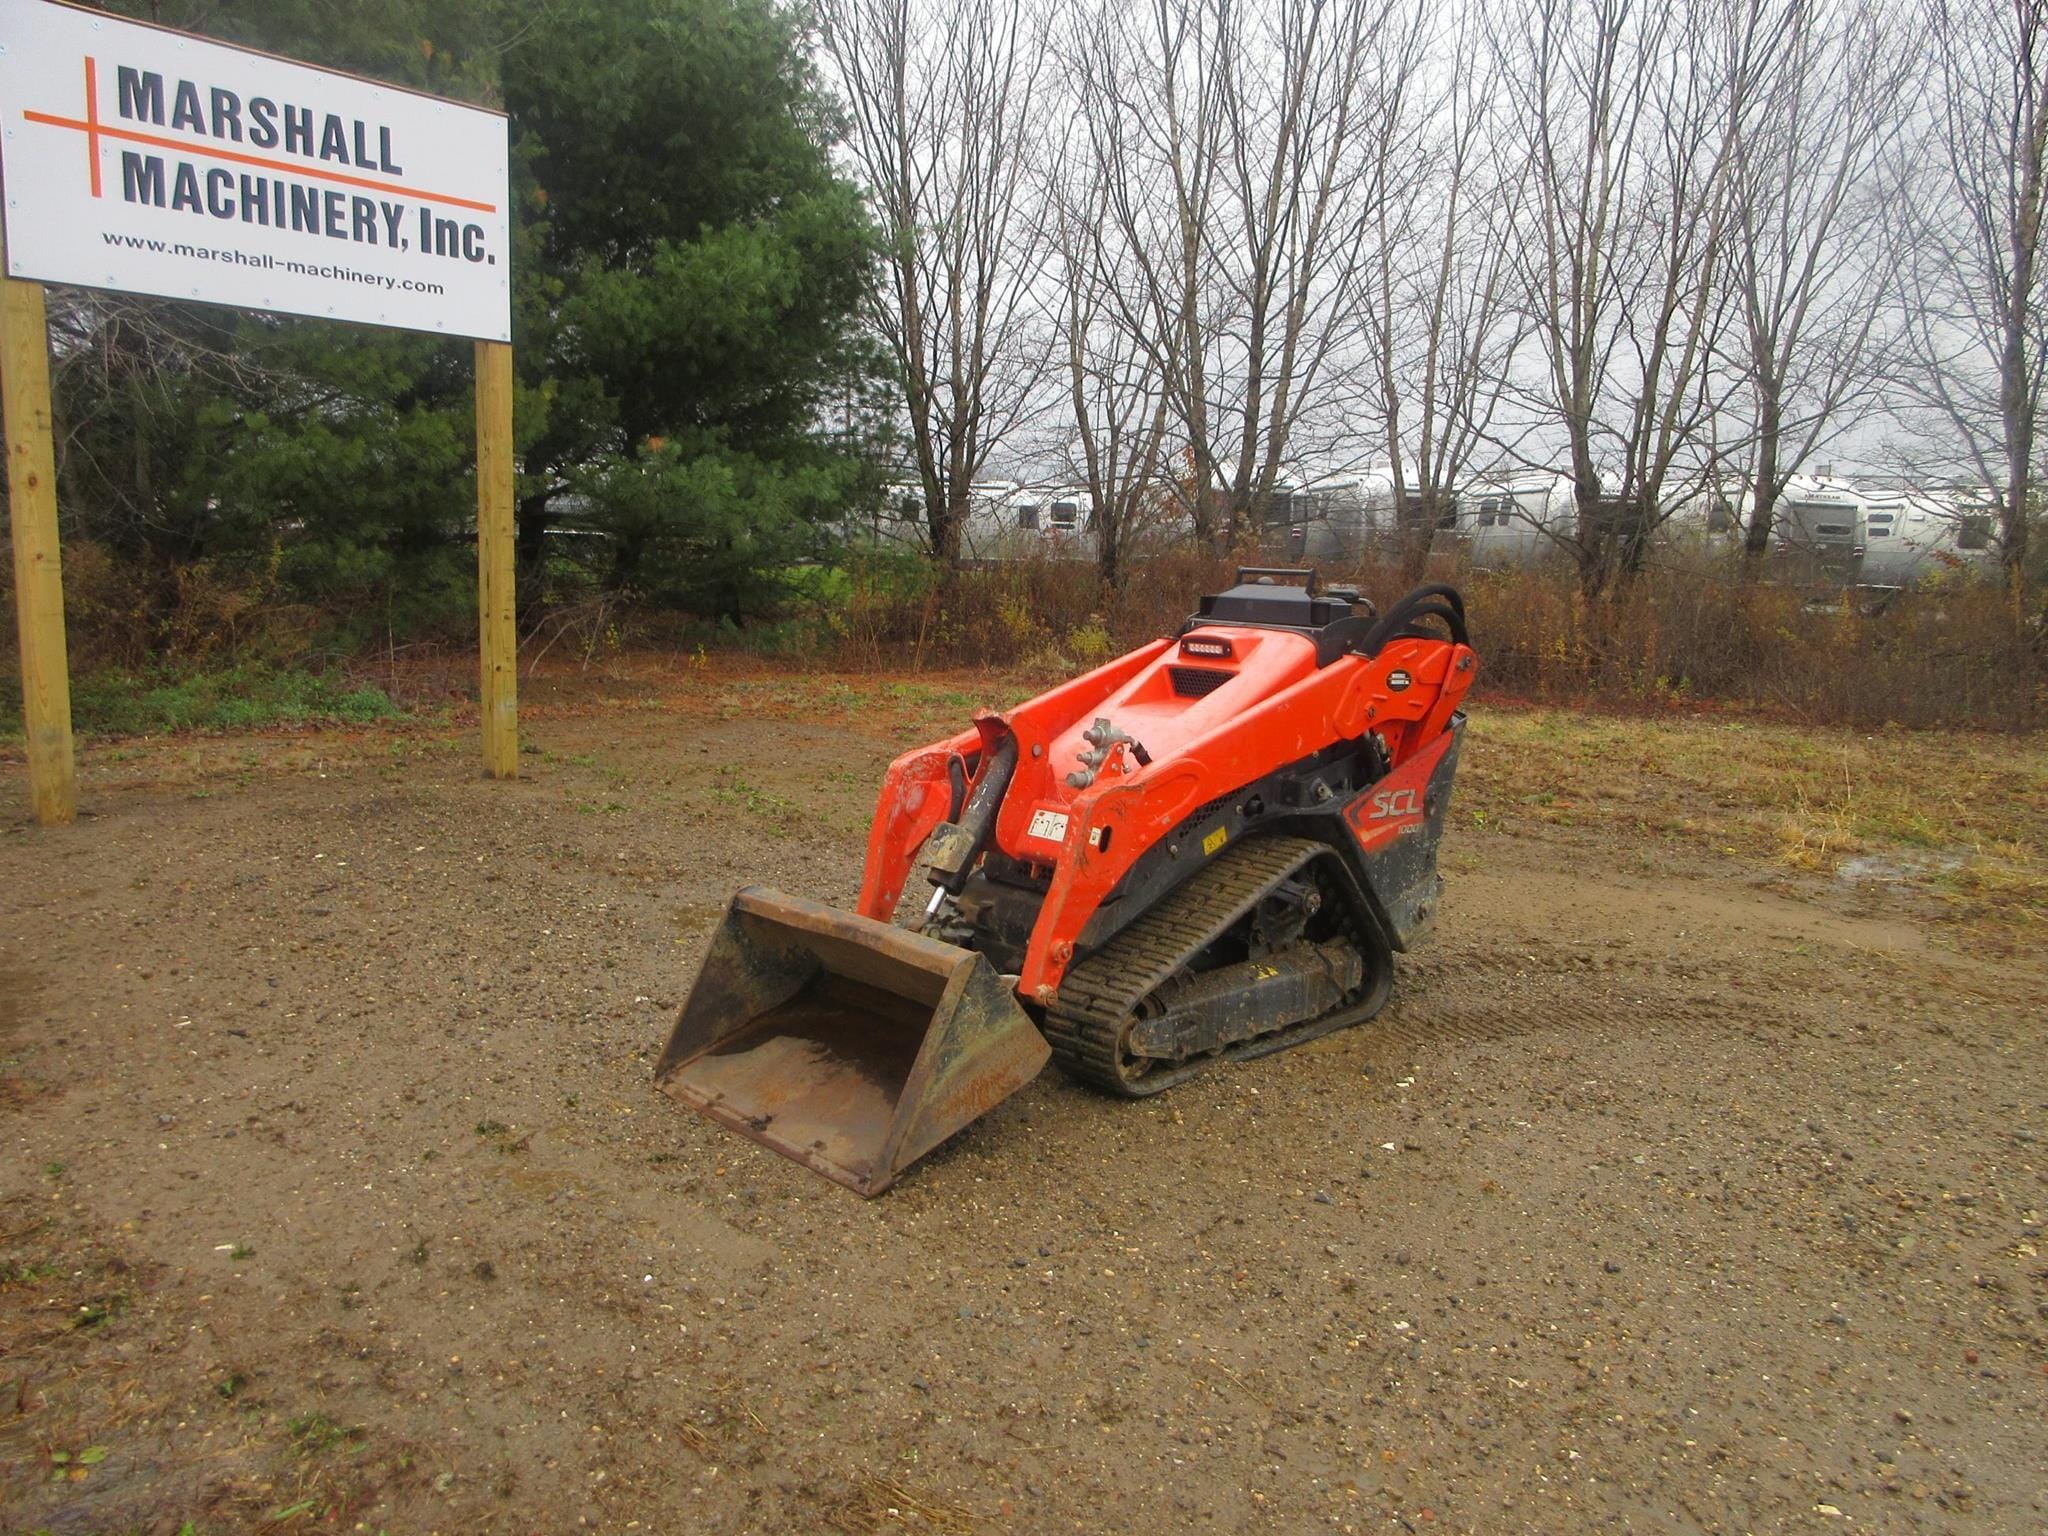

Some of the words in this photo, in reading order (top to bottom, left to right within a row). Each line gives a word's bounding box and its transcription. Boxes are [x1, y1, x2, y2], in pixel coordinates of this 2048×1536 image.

[118, 65, 404, 176] MARSHALL
[122, 150, 411, 254] MACHINERY,
[420, 207, 497, 266] Inc.
[102, 232, 445, 296] www.marshall-machinery.com
[1369, 788, 1420, 819] SCL
